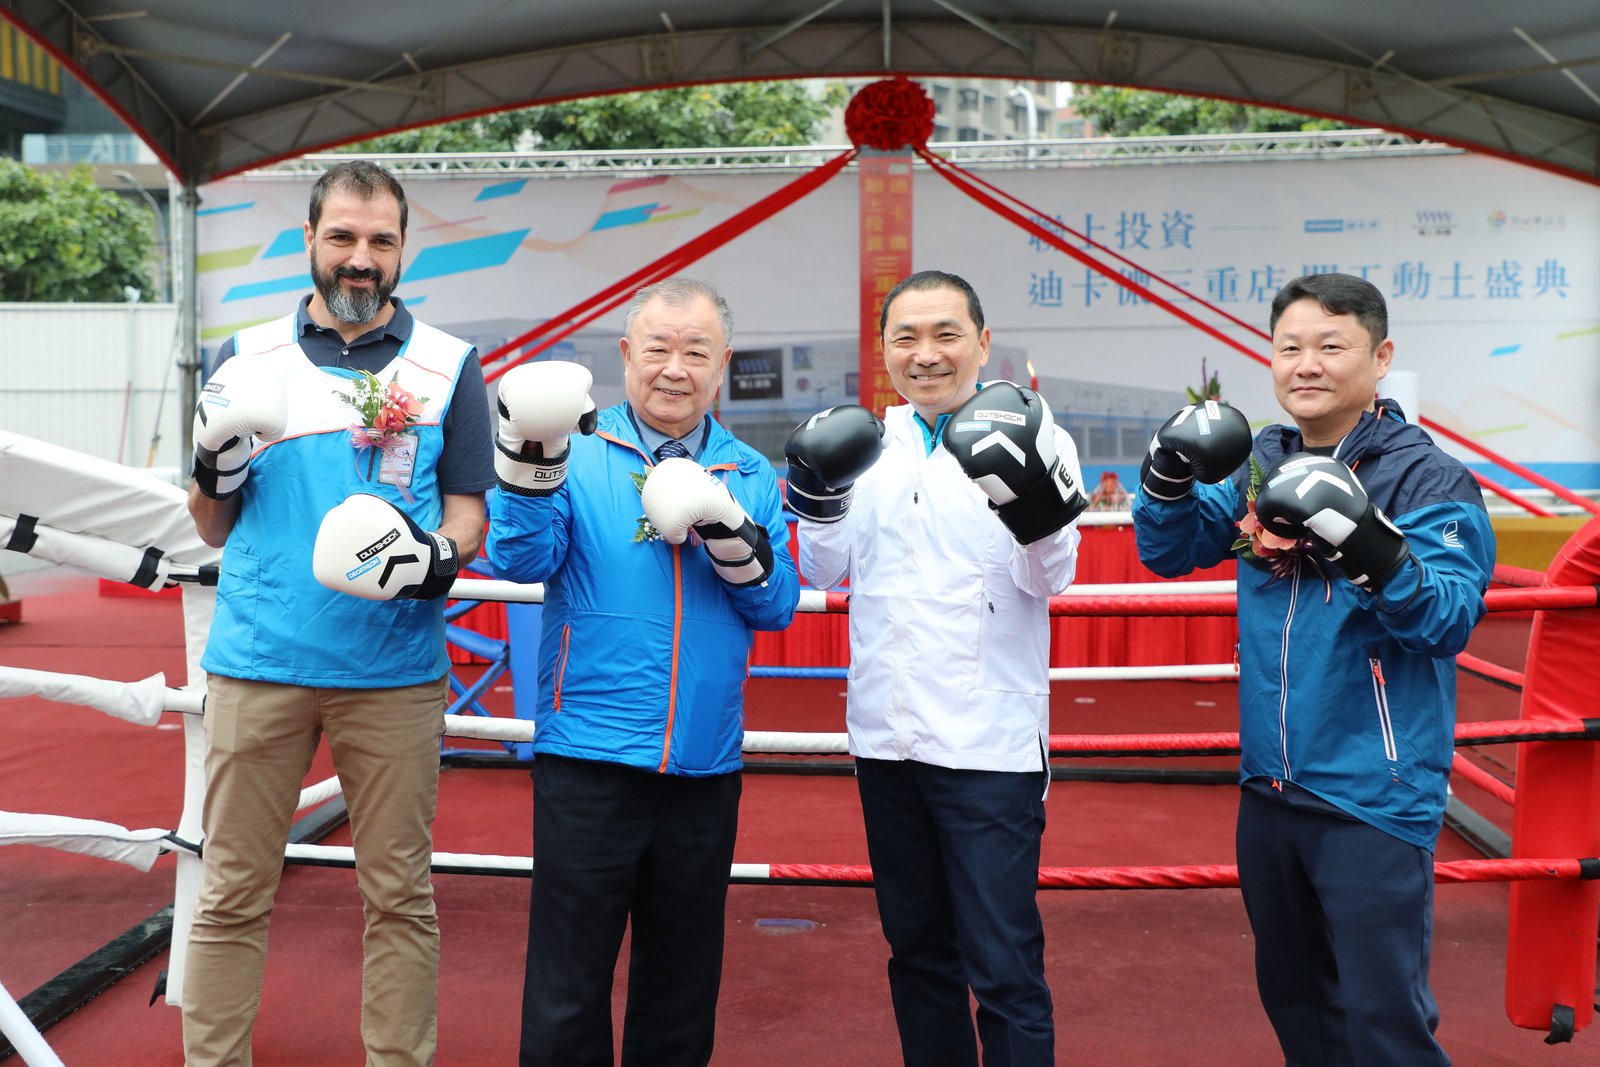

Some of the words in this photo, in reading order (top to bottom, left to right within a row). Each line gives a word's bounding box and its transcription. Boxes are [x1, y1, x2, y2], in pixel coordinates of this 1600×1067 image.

[977, 412, 1023, 423] OUTSHOCK
[359, 531, 399, 560] OUTSHOCK
[347, 558, 380, 580] DECATHLON
